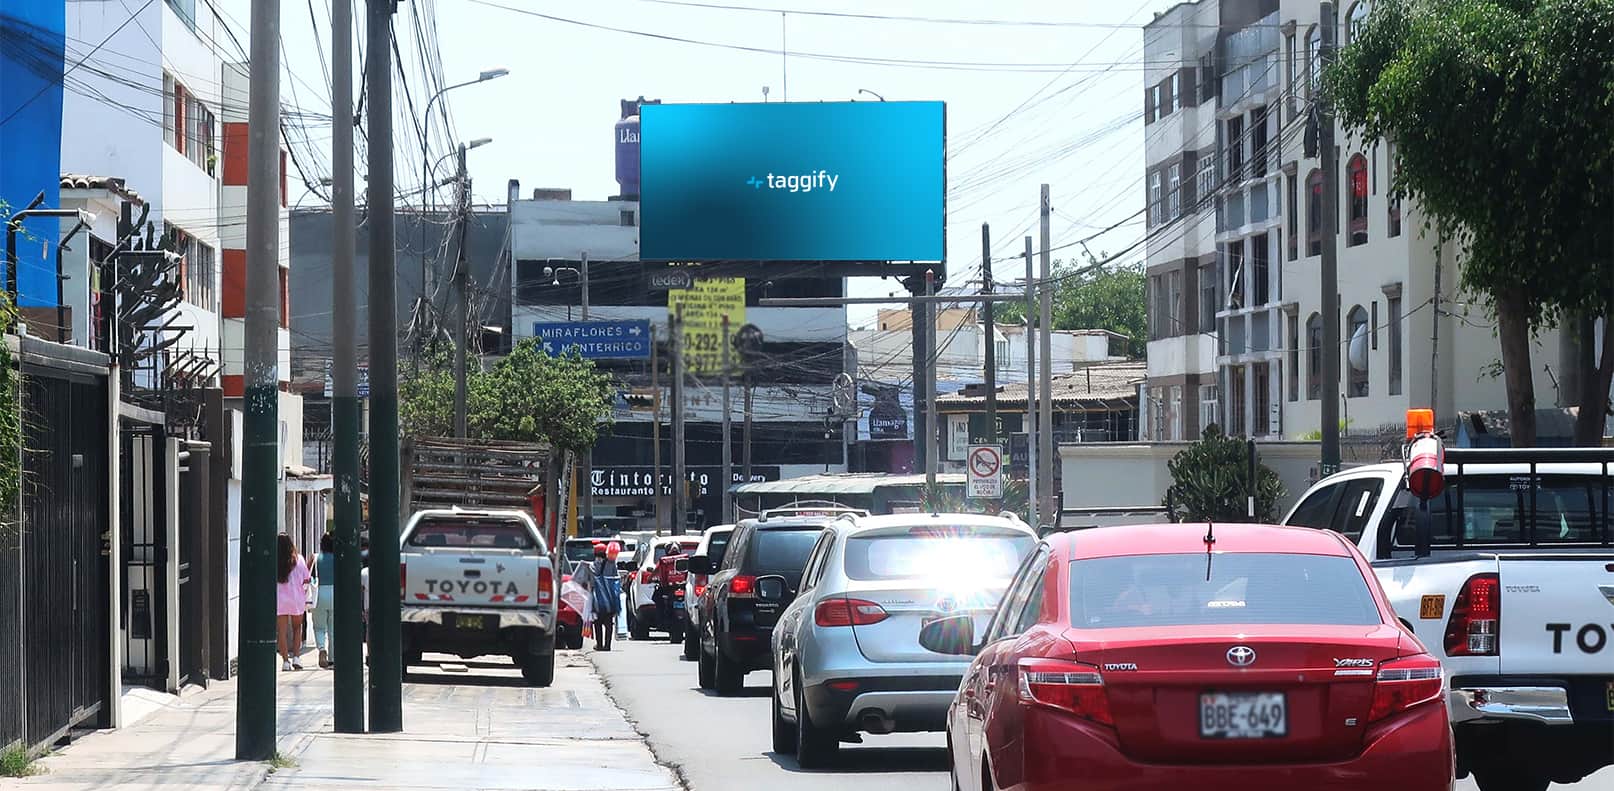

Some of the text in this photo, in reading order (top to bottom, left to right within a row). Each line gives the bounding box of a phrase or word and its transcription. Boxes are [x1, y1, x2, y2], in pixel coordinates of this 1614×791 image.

[767, 170, 839, 192] taggify
[542, 327, 623, 338] MIRAFLORES
[561, 341, 641, 354] MNTERRICO
[425, 580, 519, 594] TOYOTA
[1505, 585, 1541, 593] TOYOTA
[1545, 622, 1614, 654] TO
[1104, 663, 1138, 671] TOYOTA
[1333, 658, 1374, 667] YARIS
[1203, 703, 1282, 729] BBE-649
